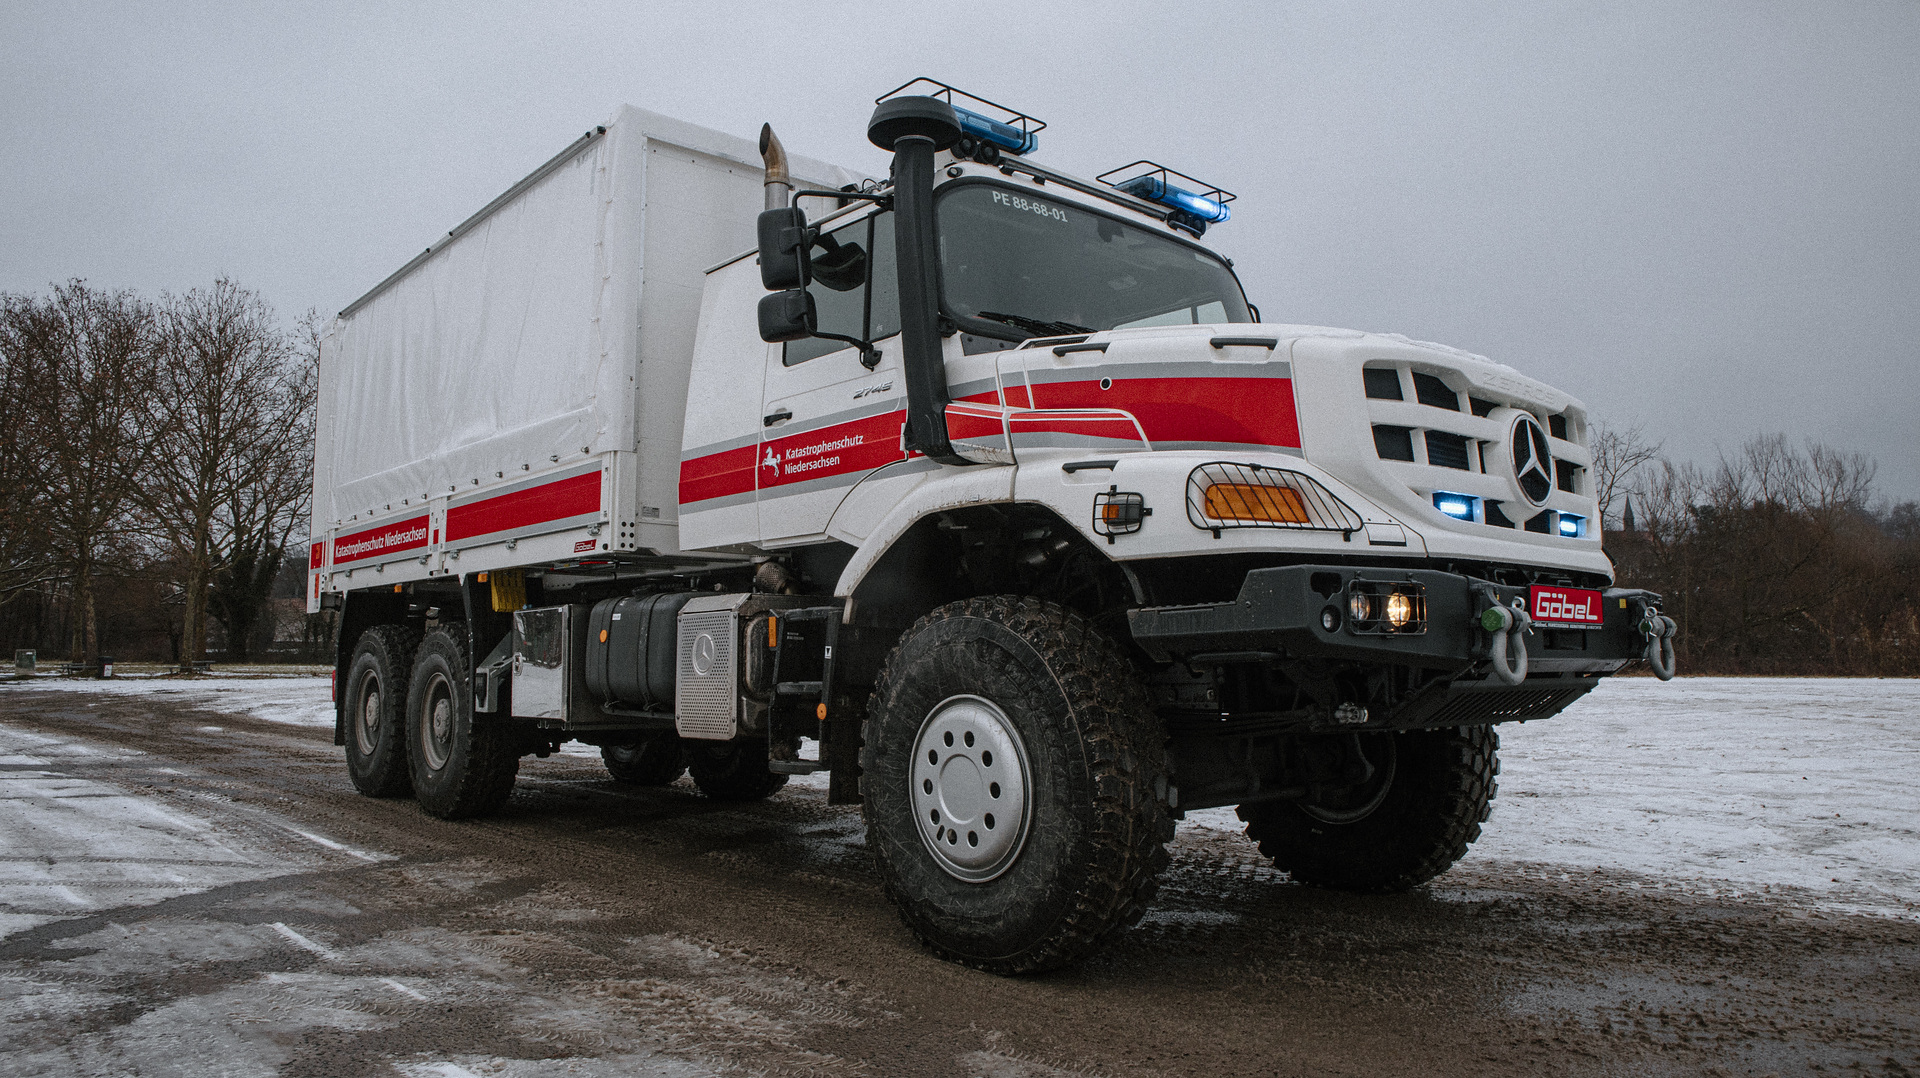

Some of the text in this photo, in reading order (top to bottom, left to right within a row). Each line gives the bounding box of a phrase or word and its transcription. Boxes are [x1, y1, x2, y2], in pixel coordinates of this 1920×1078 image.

[992, 191, 1068, 222] PE 88-68-01
[853, 380, 893, 399] 2745
[785, 435, 864, 459] Katastrophenschutz
[784, 455, 840, 474] Niedersachsen
[335, 526, 427, 558] Katastrophenschutz Niedersachsen
